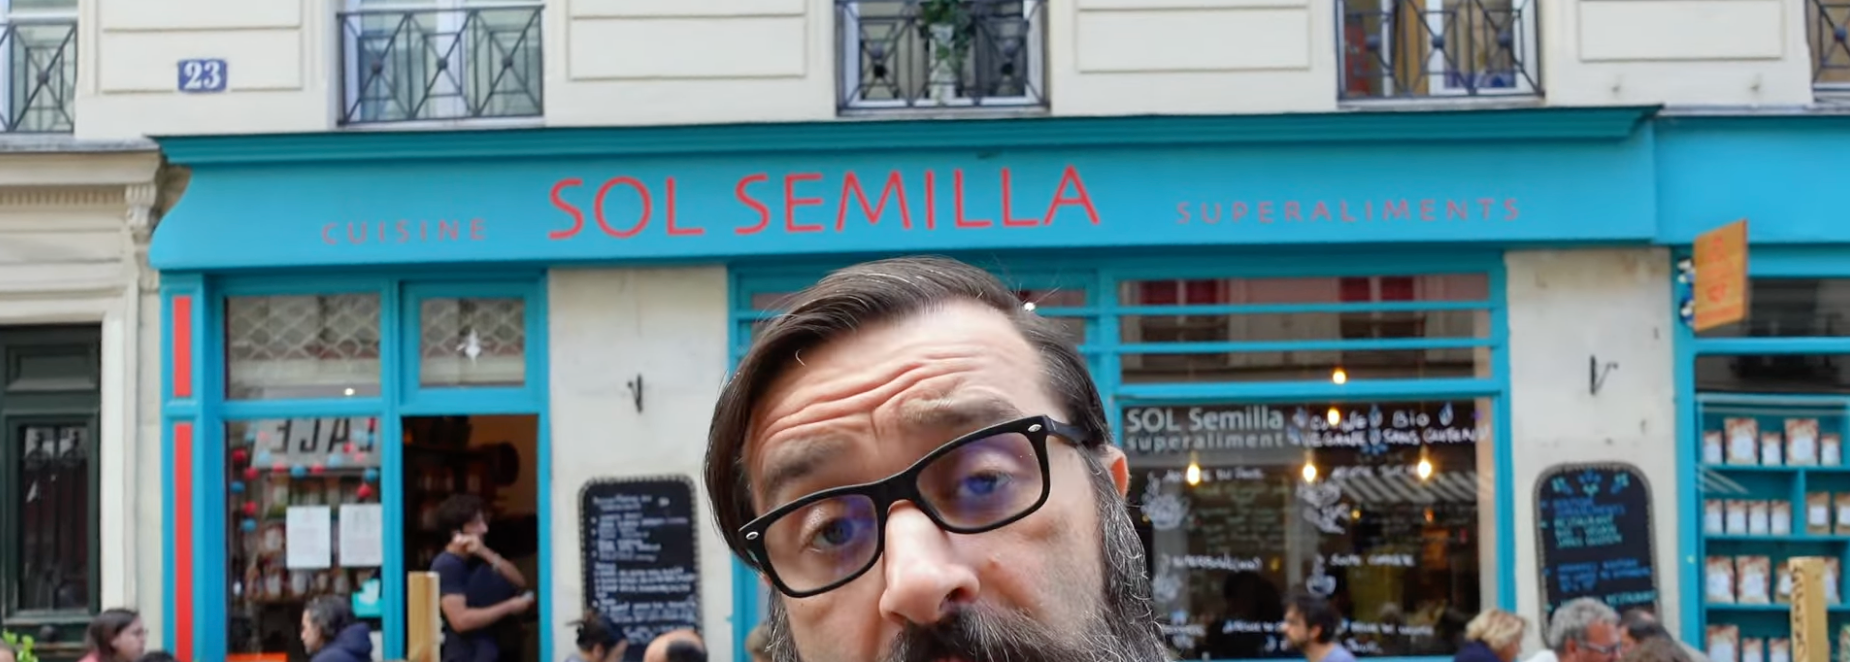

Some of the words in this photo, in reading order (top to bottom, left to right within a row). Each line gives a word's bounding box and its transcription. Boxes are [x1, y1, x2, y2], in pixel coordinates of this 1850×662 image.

[184, 61, 221, 89] 23
[547, 175, 706, 240] SOL
[733, 164, 1101, 237] SEMILLA
[1175, 197, 1520, 224] SUPERALIMENTS
[321, 219, 486, 245] CUISINE
[1126, 406, 1181, 433] SOL
[1188, 404, 1285, 431] Semilla
[1126, 431, 1285, 454] superaliment
